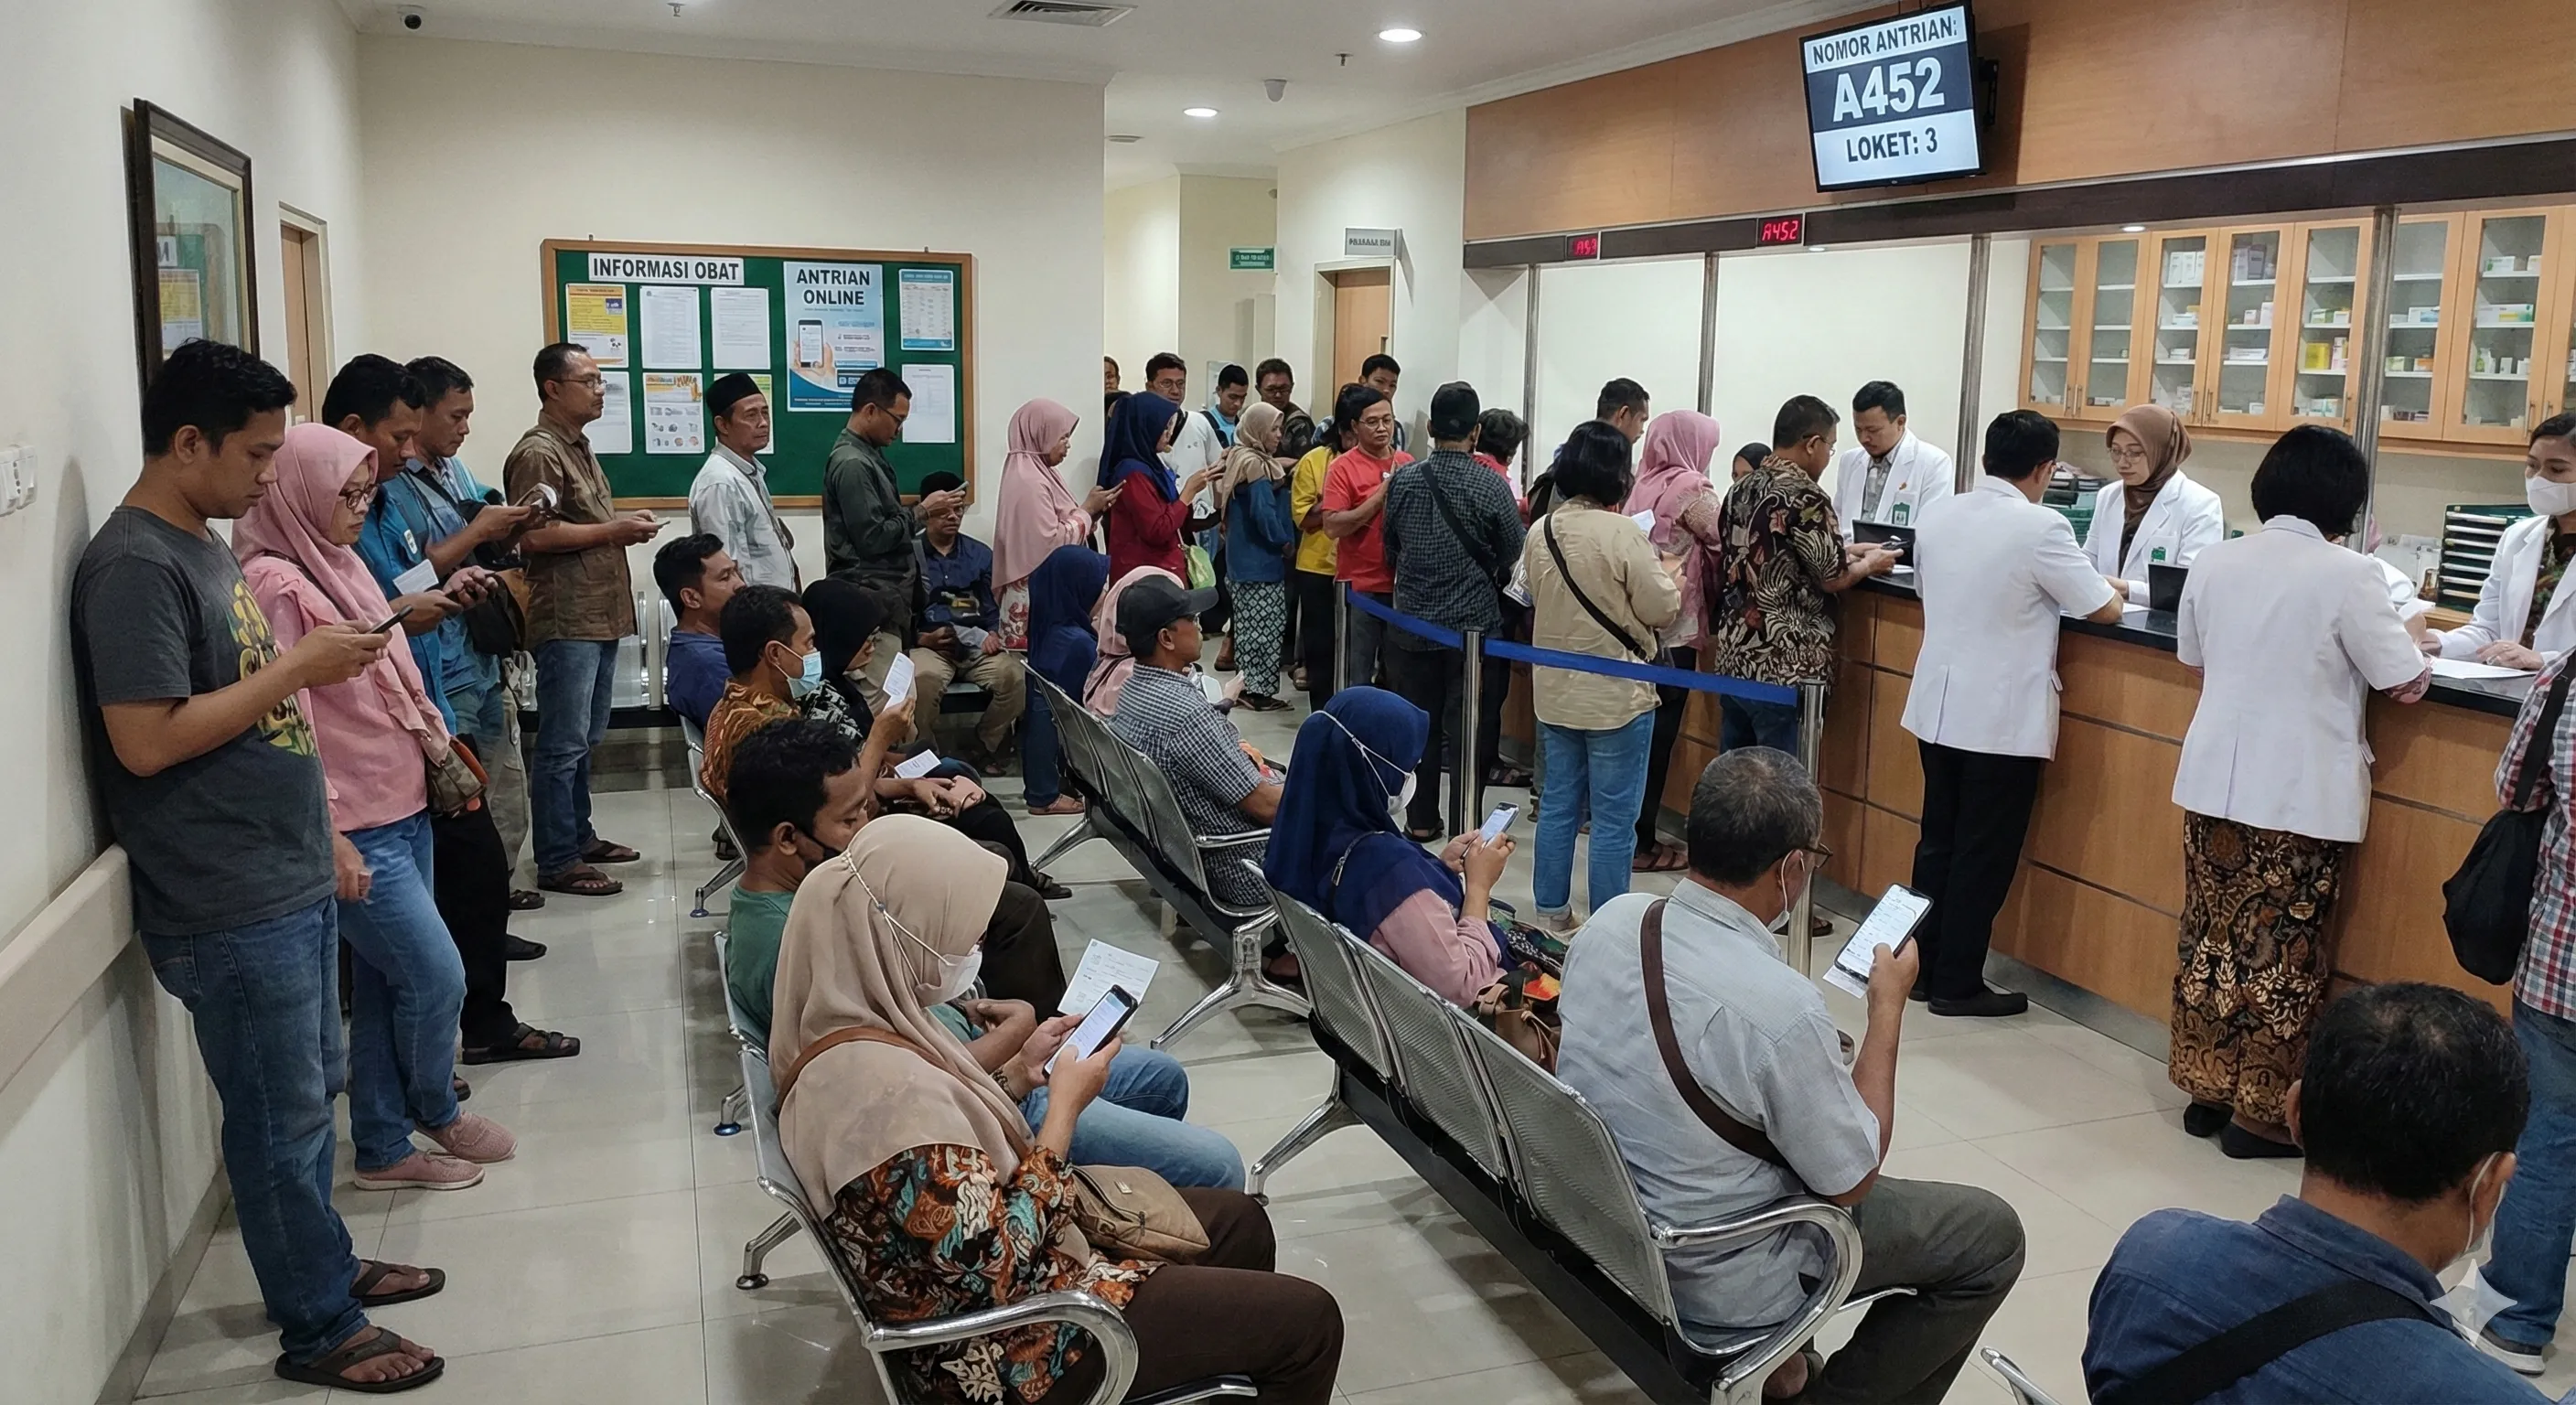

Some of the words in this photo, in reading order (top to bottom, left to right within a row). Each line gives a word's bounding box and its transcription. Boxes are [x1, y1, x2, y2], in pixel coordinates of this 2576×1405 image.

[1813, 37, 1872, 65] NOMOR
[1876, 16, 1958, 53] ANTRIAN:
[1832, 57, 1945, 123] A452
[1846, 131, 1918, 162] LOKET:
[1926, 127, 1937, 153] 3
[1762, 220, 1798, 241] A452
[594, 258, 689, 279] INFORMASI
[694, 262, 739, 280] OBAT
[797, 269, 870, 285] ANTRIAN
[803, 290, 864, 305] ONLINE
